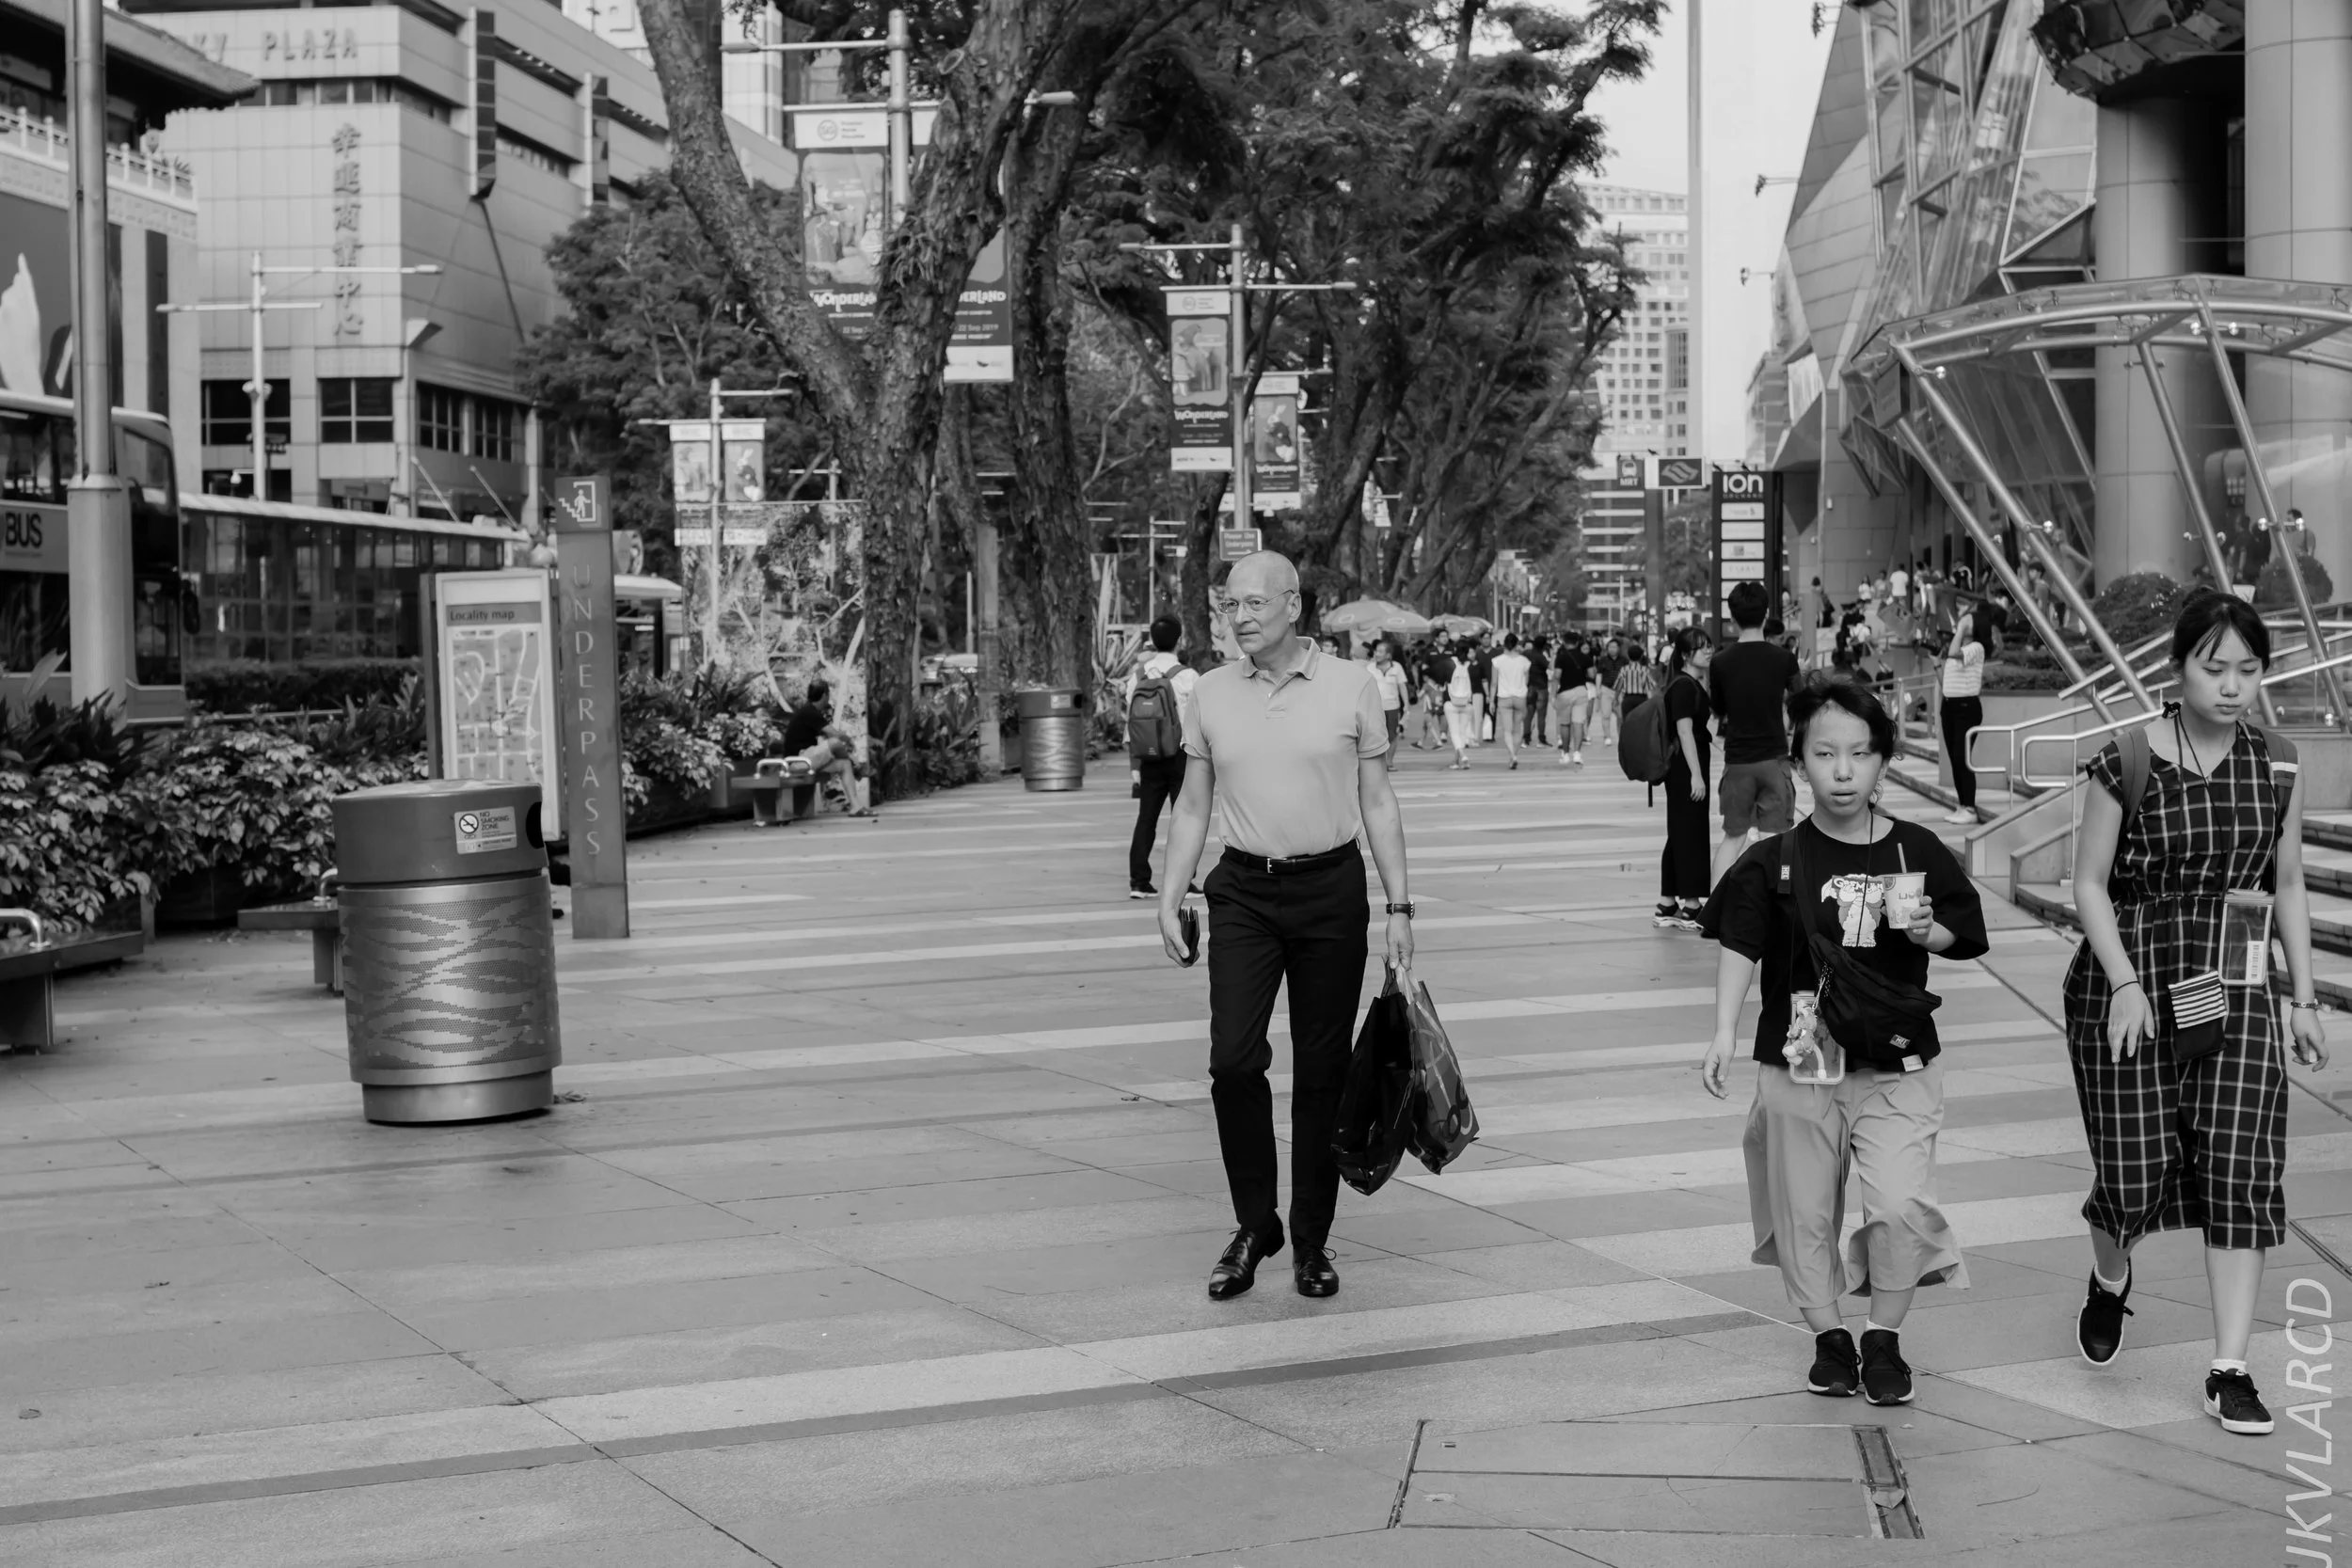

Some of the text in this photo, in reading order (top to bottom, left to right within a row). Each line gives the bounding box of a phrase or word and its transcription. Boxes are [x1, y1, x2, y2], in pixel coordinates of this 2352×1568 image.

[262, 28, 358, 61] PLAZA
[1620, 478, 1638, 486] MRT
[5, 512, 42, 549] BUS
[450, 610, 515, 621] Locality map
[572, 563, 601, 856] UNDERPASS
